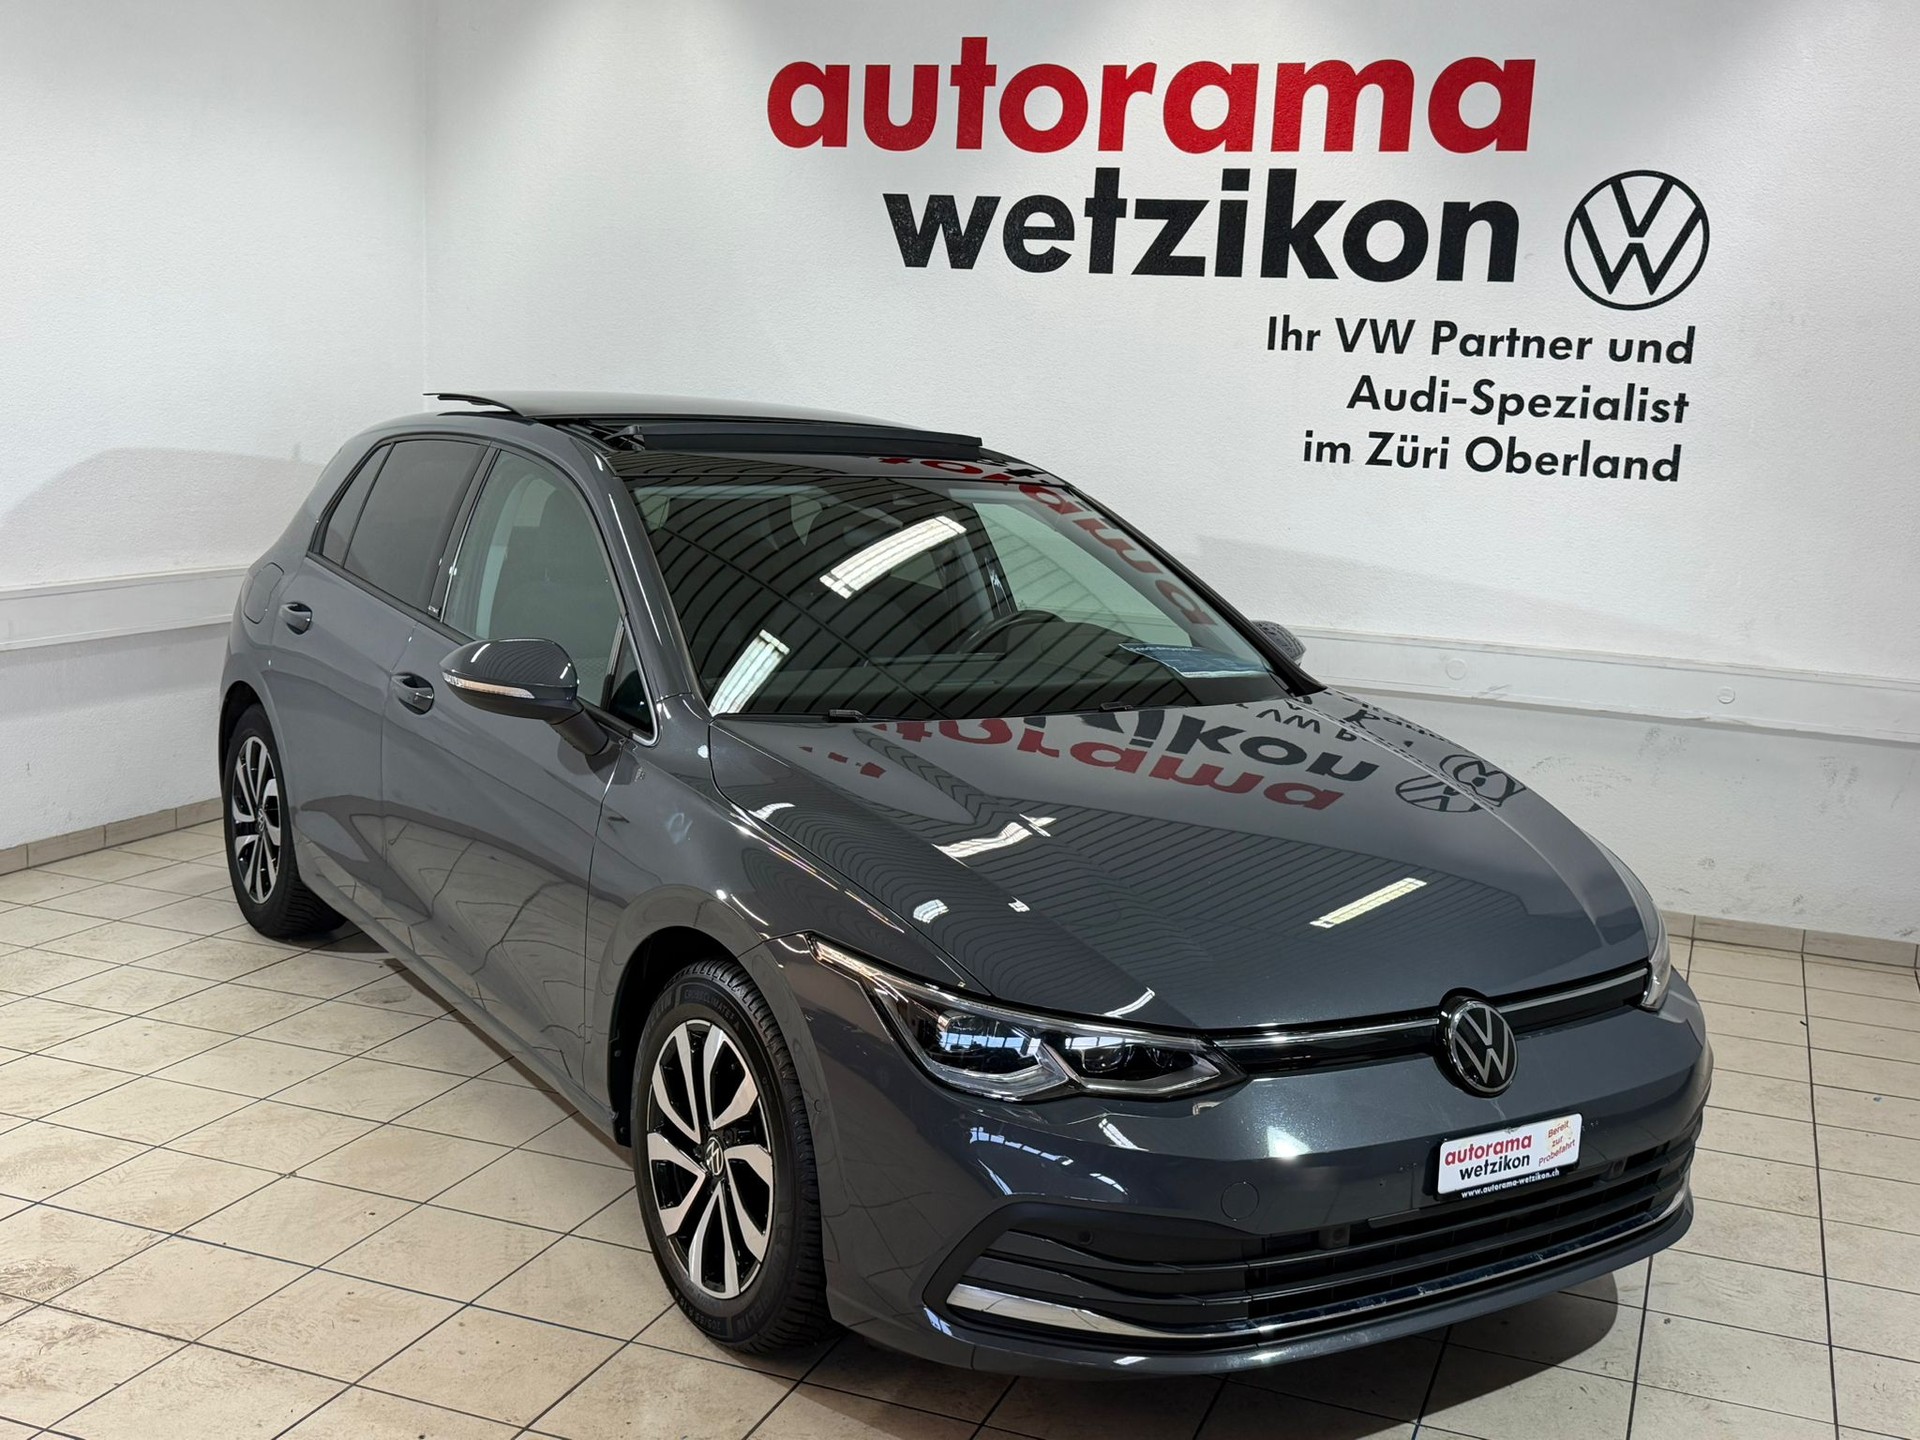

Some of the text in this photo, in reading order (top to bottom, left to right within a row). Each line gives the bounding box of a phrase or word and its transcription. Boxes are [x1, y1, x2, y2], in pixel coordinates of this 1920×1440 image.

[767, 36, 1536, 154] autorama
[882, 167, 1520, 283] wetzikon
[1267, 315, 1696, 365] Ihr VW Partner und
[1346, 374, 1690, 426] Audi-Spezialist
[1303, 430, 1682, 482] im Züri Oberland
[1449, 1000, 1518, 1094] VW
[1444, 1134, 1533, 1166] autorama
[1547, 1120, 1569, 1139] Bereit
[1551, 1135, 1564, 1148] zur
[1459, 1154, 1530, 1181] wetzikon
[1538, 1138, 1576, 1167] Probefahrt
[1460, 1168, 1560, 1199] www.autorama-wetzikon.ch
